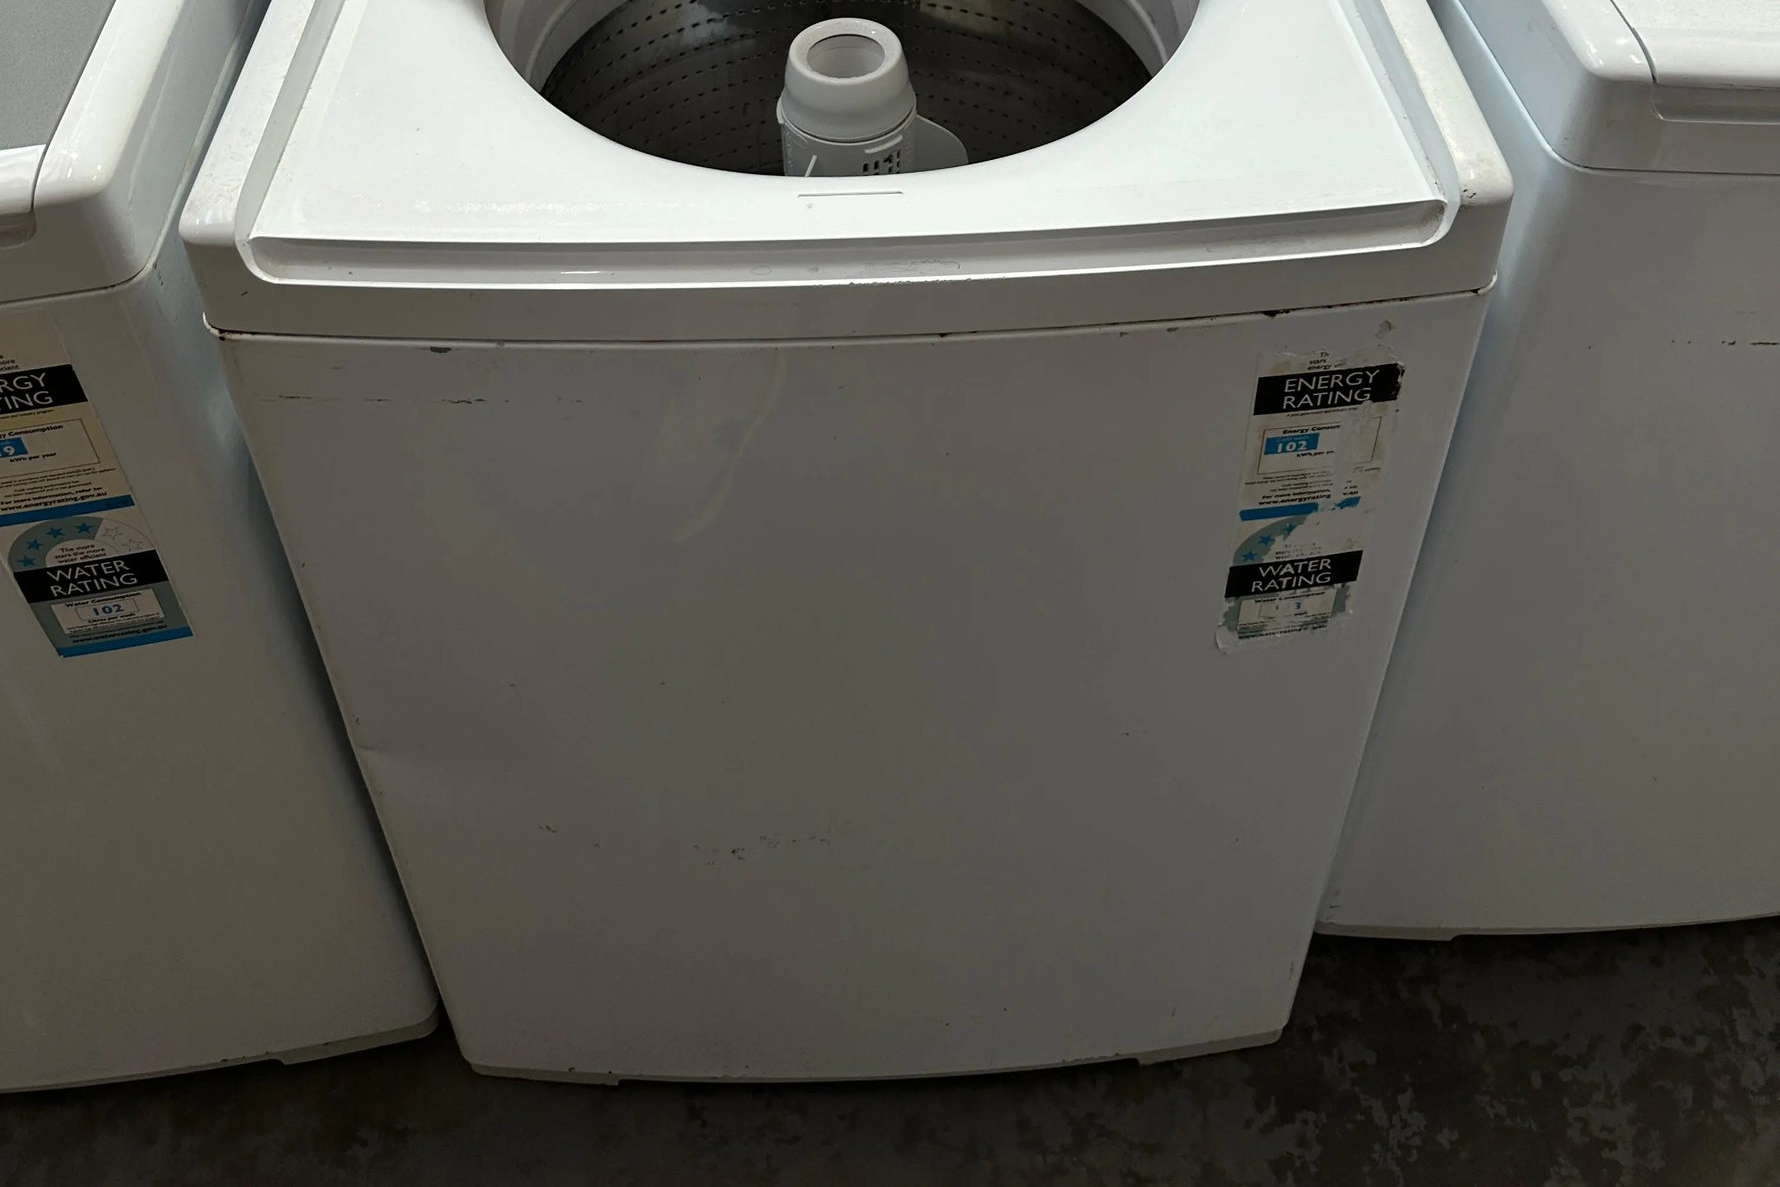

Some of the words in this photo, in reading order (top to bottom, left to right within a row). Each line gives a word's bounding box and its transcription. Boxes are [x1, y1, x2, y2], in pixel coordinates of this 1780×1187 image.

[1284, 370, 1380, 392] ENERGY
[0, 390, 54, 412] ING
[1282, 388, 1372, 409] RATING
[8, 424, 63, 436] Consumption
[1277, 441, 1307, 453] 102
[0, 492, 107, 511] www.energyrating.gov.au
[46, 560, 130, 582] WATER
[1259, 558, 1332, 578] WATER
[50, 572, 138, 597] RATING
[1252, 572, 1332, 592] RATING
[65, 600, 89, 608] Water
[91, 592, 141, 603] Consumption
[93, 604, 124, 616] 102
